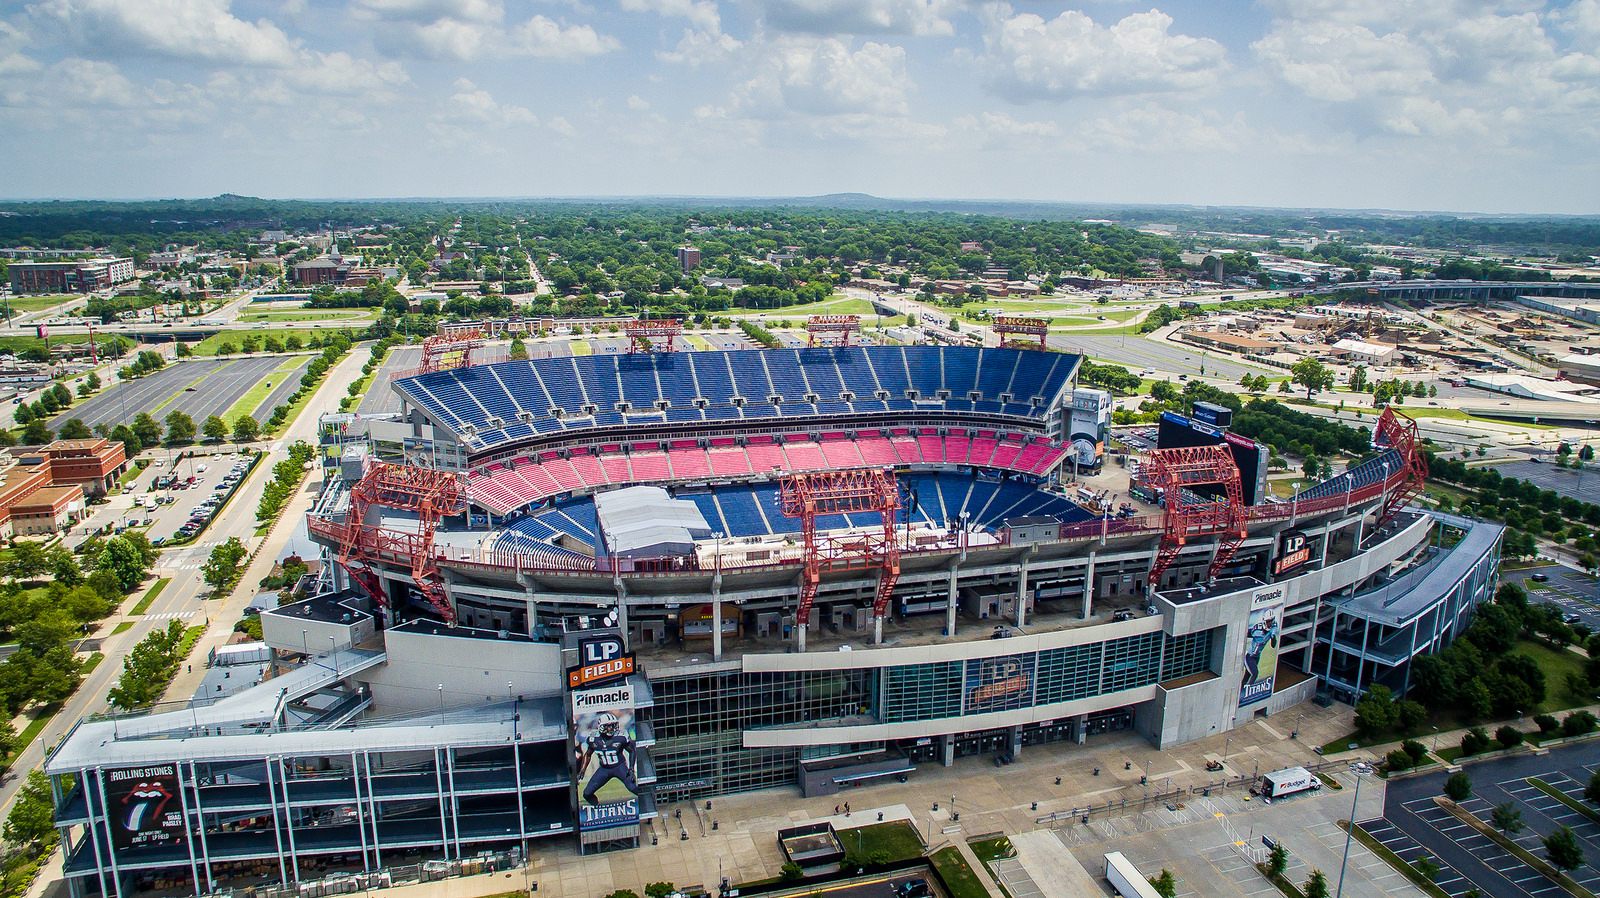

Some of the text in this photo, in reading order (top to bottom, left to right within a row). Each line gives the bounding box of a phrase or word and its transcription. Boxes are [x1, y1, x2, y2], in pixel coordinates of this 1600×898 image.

[1286, 536, 1304, 553] LP
[1282, 551, 1305, 567] FIELD
[1255, 589, 1282, 603] Pinnacle
[585, 641, 619, 662] LP
[584, 660, 623, 679] FIELD
[1243, 677, 1271, 697] TITANS
[576, 689, 630, 706] Pinnacle
[113, 769, 144, 781] ROLLING
[145, 766, 173, 777] STONES
[1287, 779, 1306, 788] Budget
[582, 799, 637, 822] TITANS
